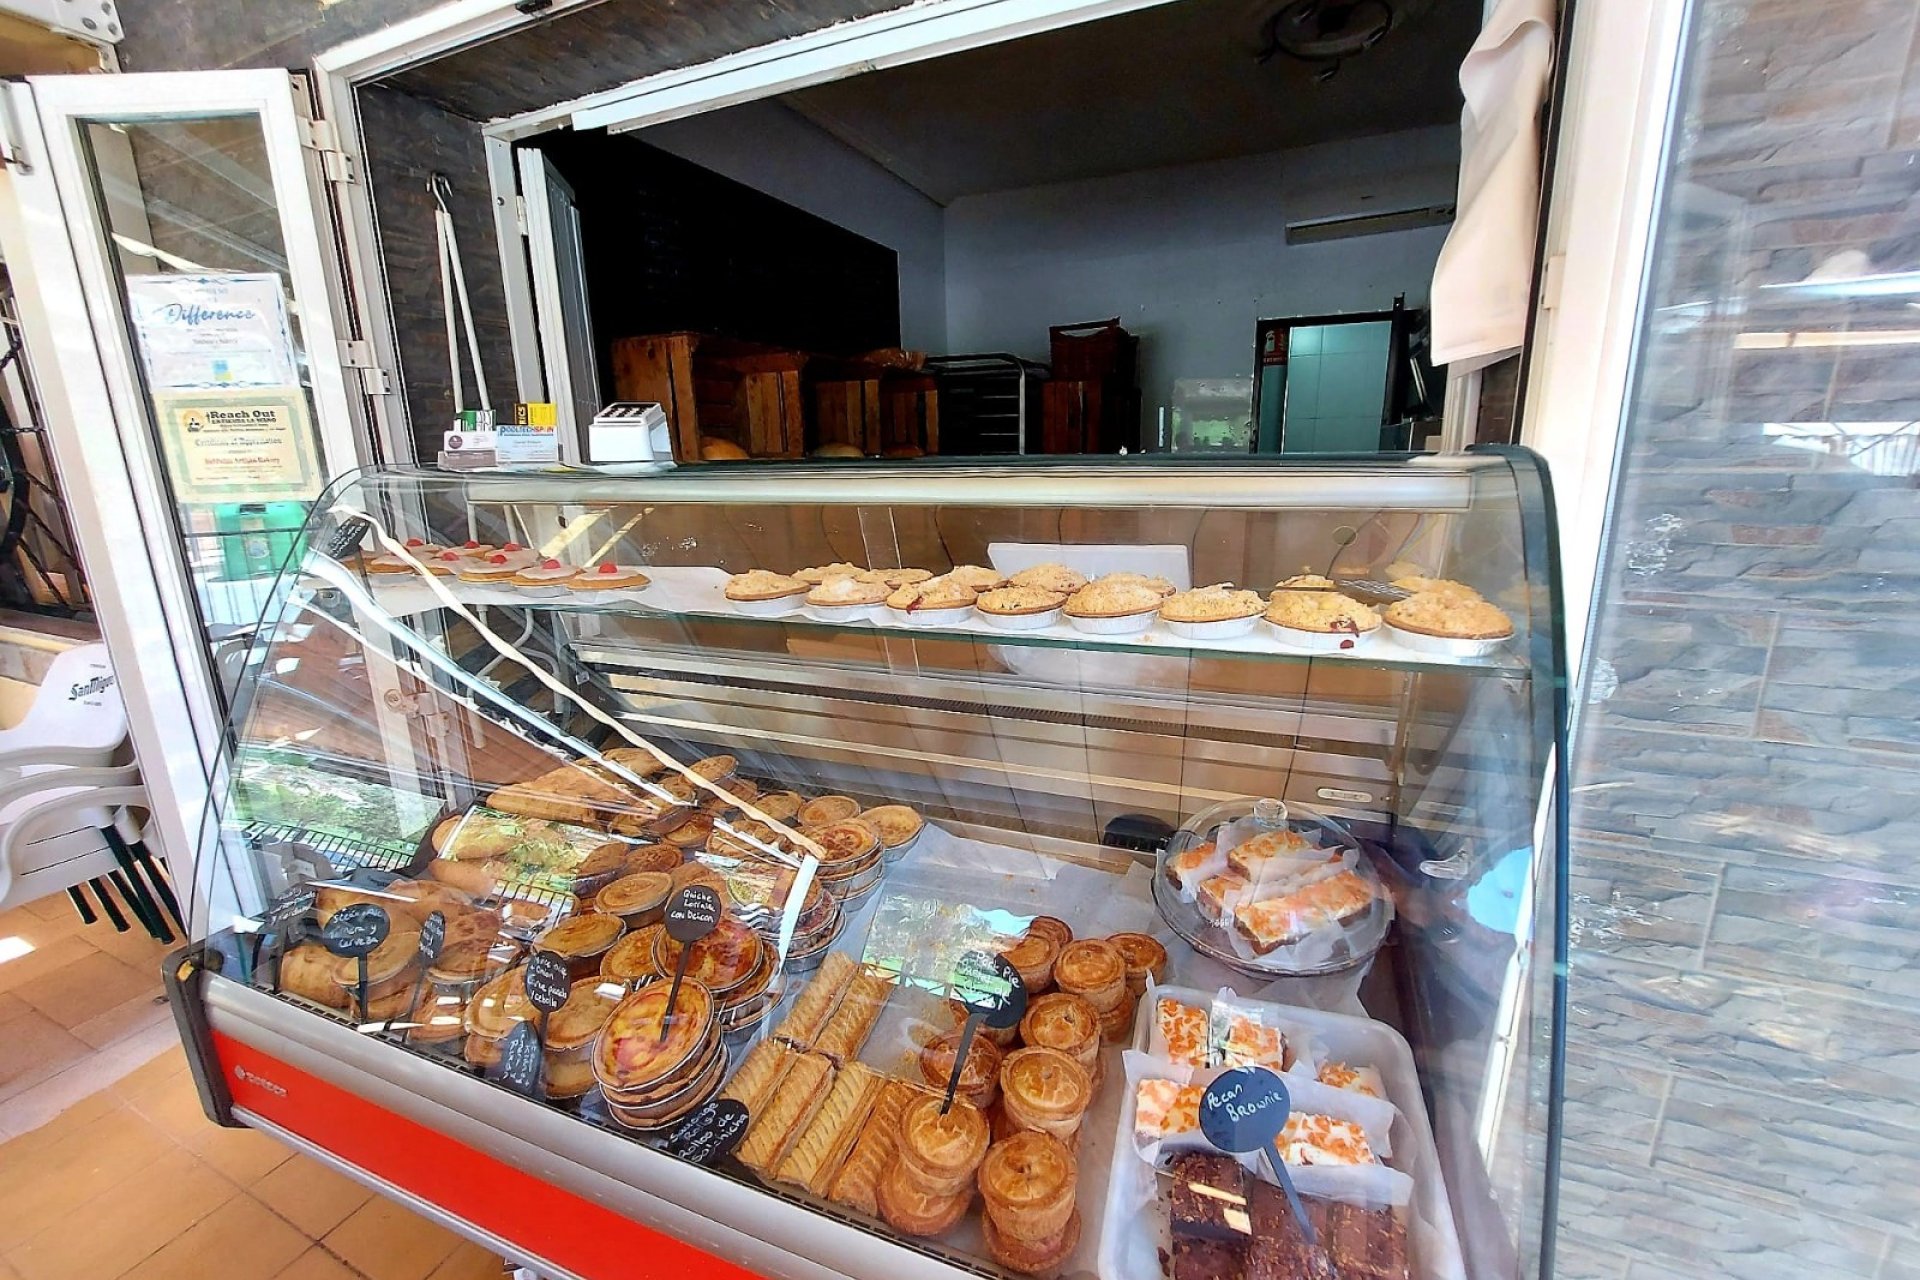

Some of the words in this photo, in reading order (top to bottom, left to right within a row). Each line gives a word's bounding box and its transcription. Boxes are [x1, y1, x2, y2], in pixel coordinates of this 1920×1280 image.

[154, 303, 255, 325] Difference
[210, 410, 250, 419] Reach
[252, 410, 276, 418] Out
[683, 889, 713, 902] Quiche
[1002, 965, 1021, 989] Pie
[1207, 1083, 1243, 1111] Pecan
[718, 1113, 735, 1127] de
